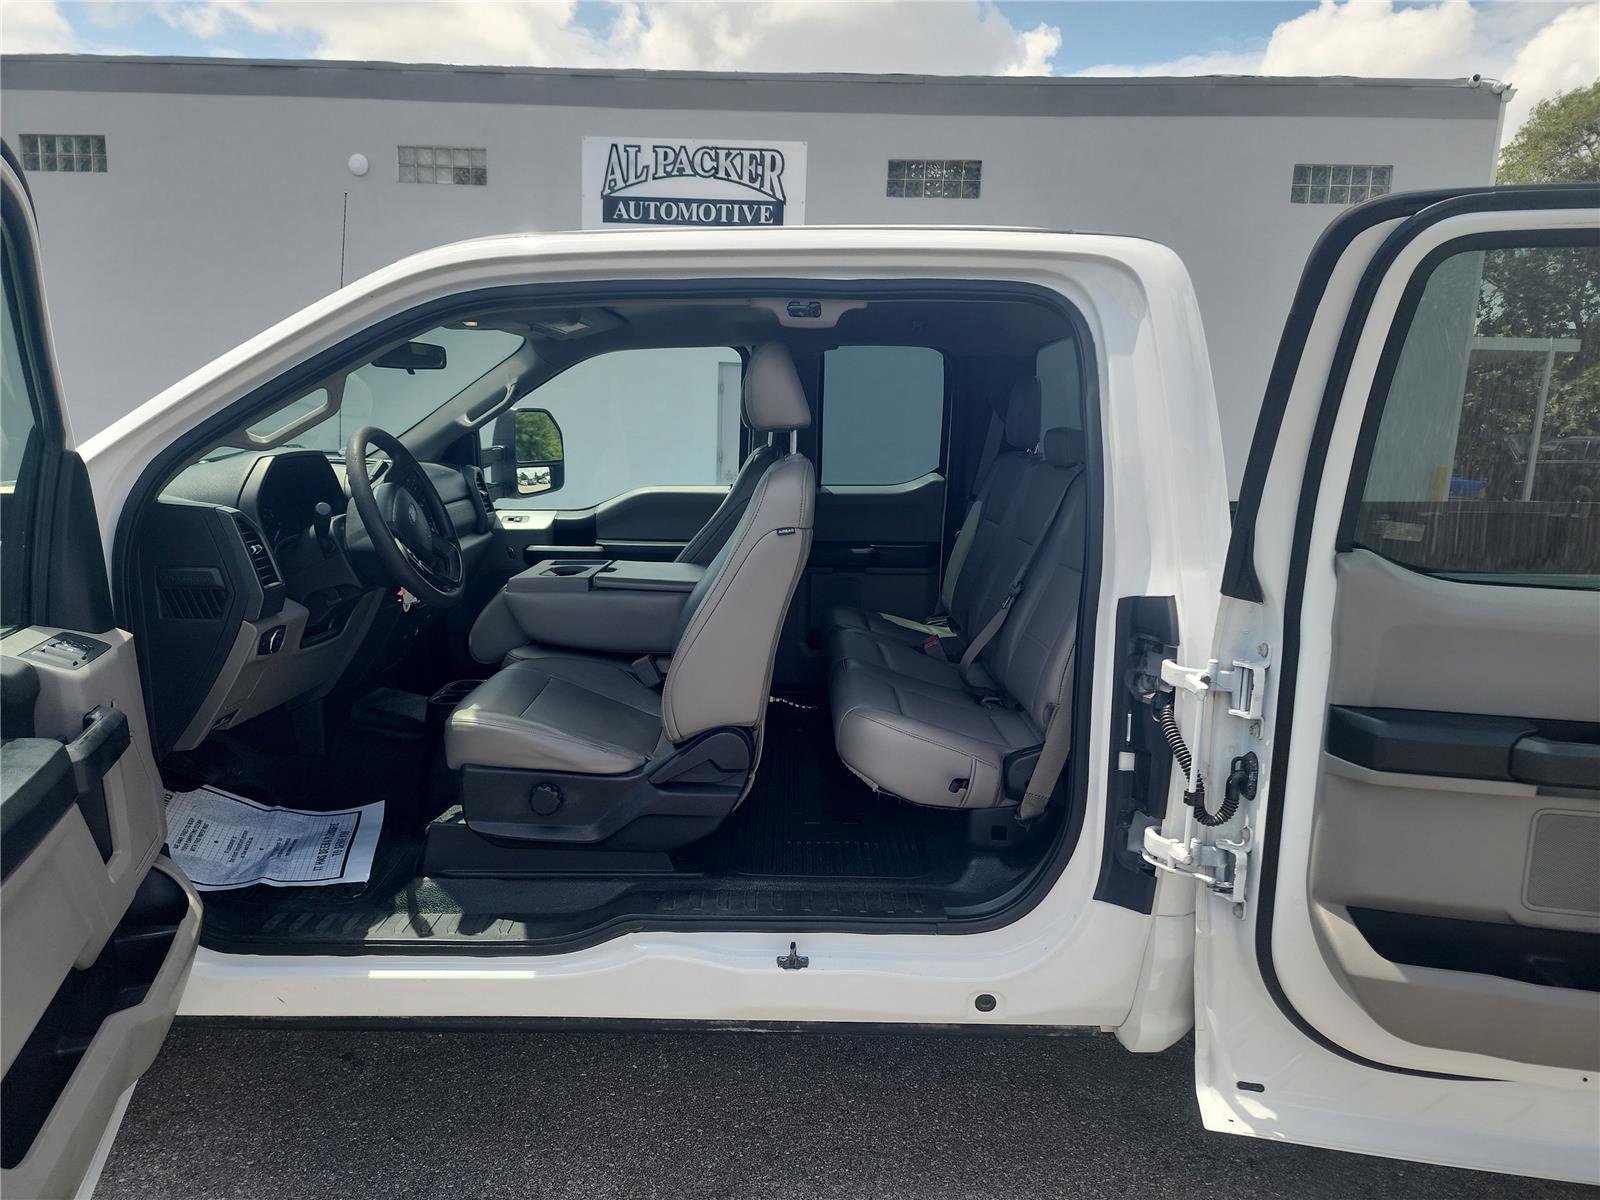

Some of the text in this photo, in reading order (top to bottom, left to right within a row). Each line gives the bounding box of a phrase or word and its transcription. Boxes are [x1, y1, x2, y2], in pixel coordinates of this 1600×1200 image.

[601, 144, 786, 204] AL PACKER
[613, 201, 774, 223] AUTOMOTIVE
